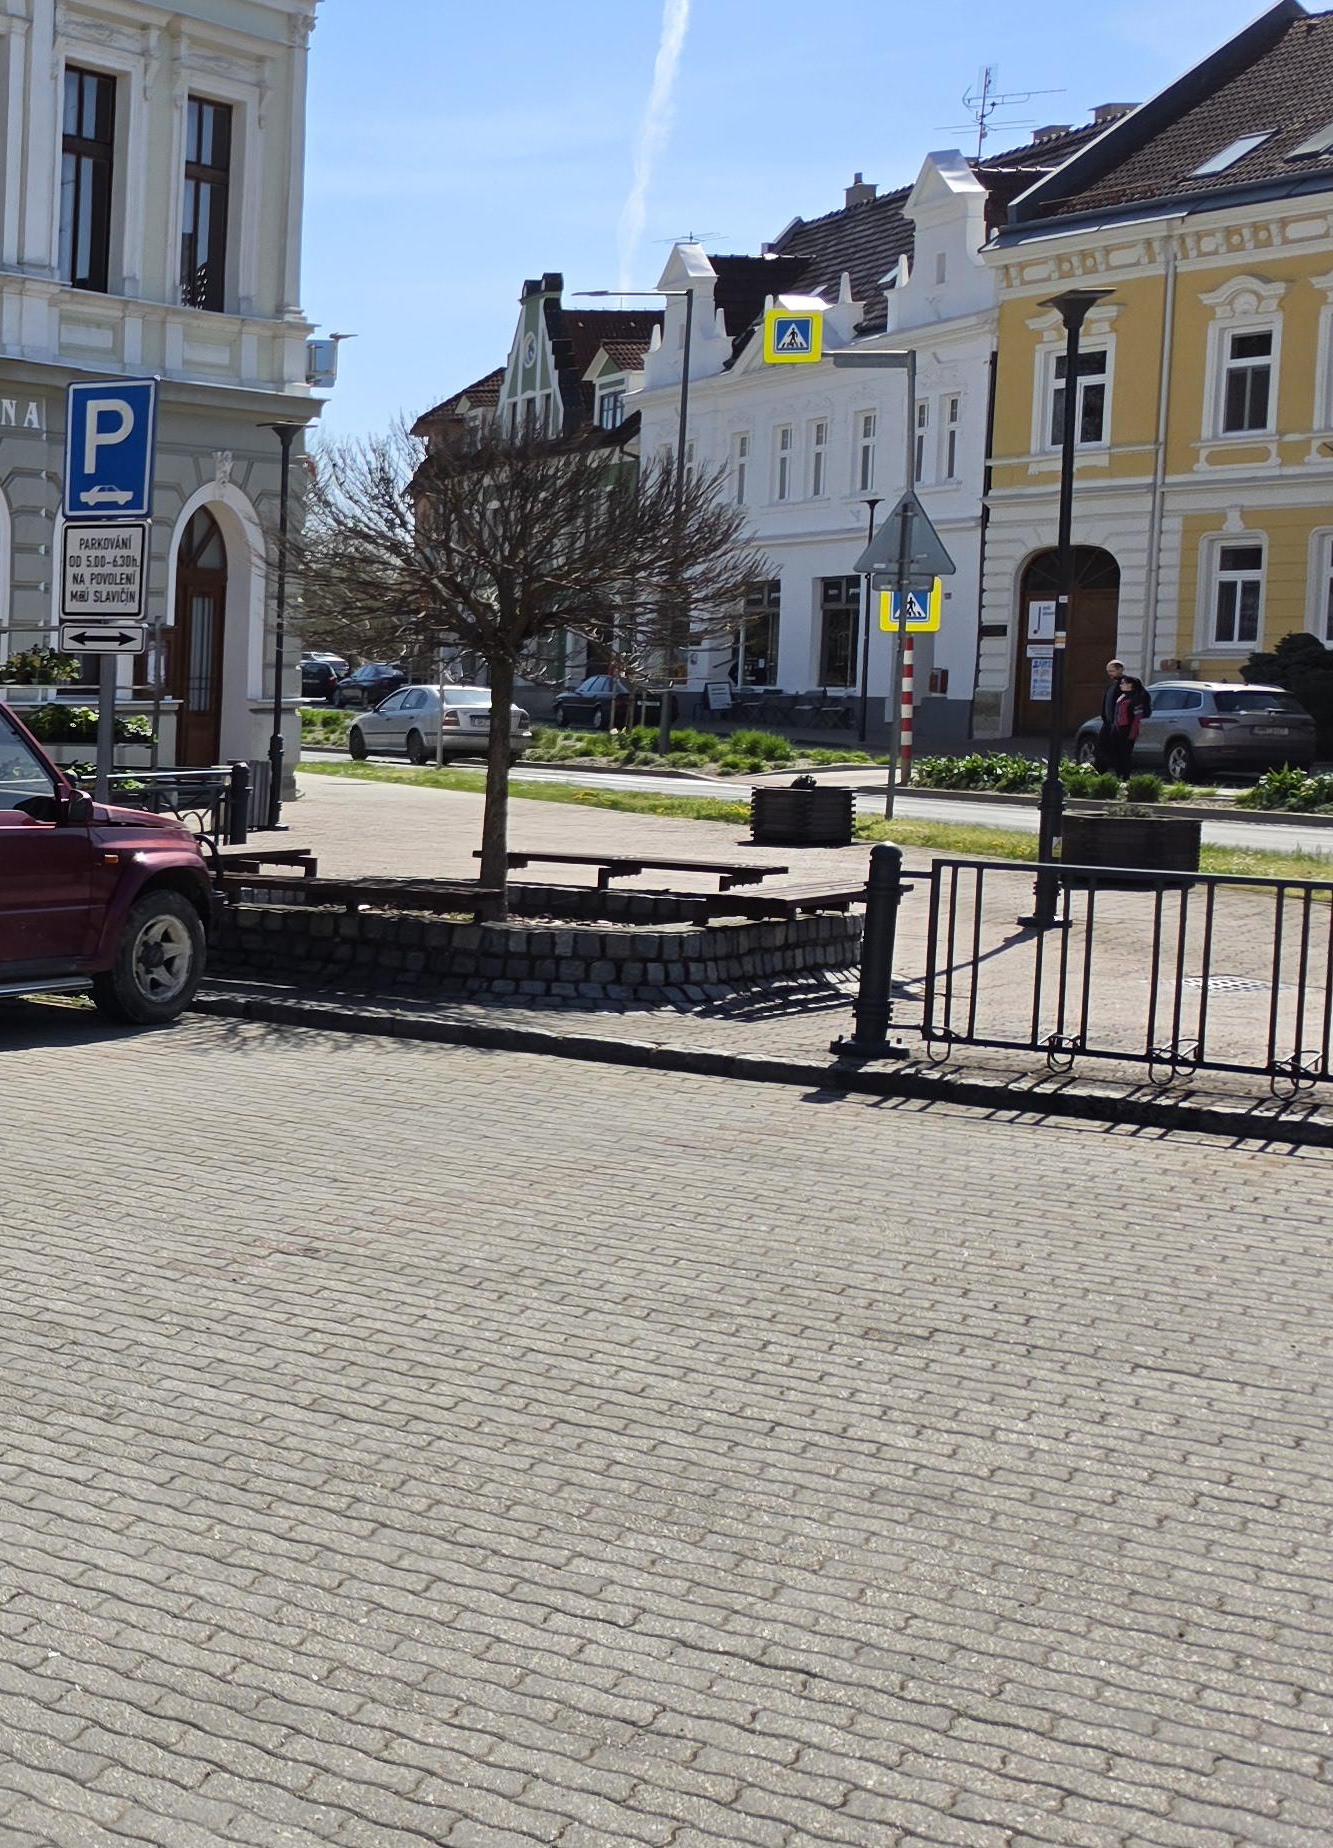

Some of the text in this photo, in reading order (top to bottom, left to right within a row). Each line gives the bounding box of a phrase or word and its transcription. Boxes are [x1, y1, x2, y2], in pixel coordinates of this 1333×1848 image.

[84, 398, 134, 474] P
[79, 534, 133, 551] PARKOVÁNÍ
[68, 555, 83, 568] OD
[72, 569, 137, 586] NA POVOLENÍ
[92, 587, 136, 604] SLAVIČÍN
